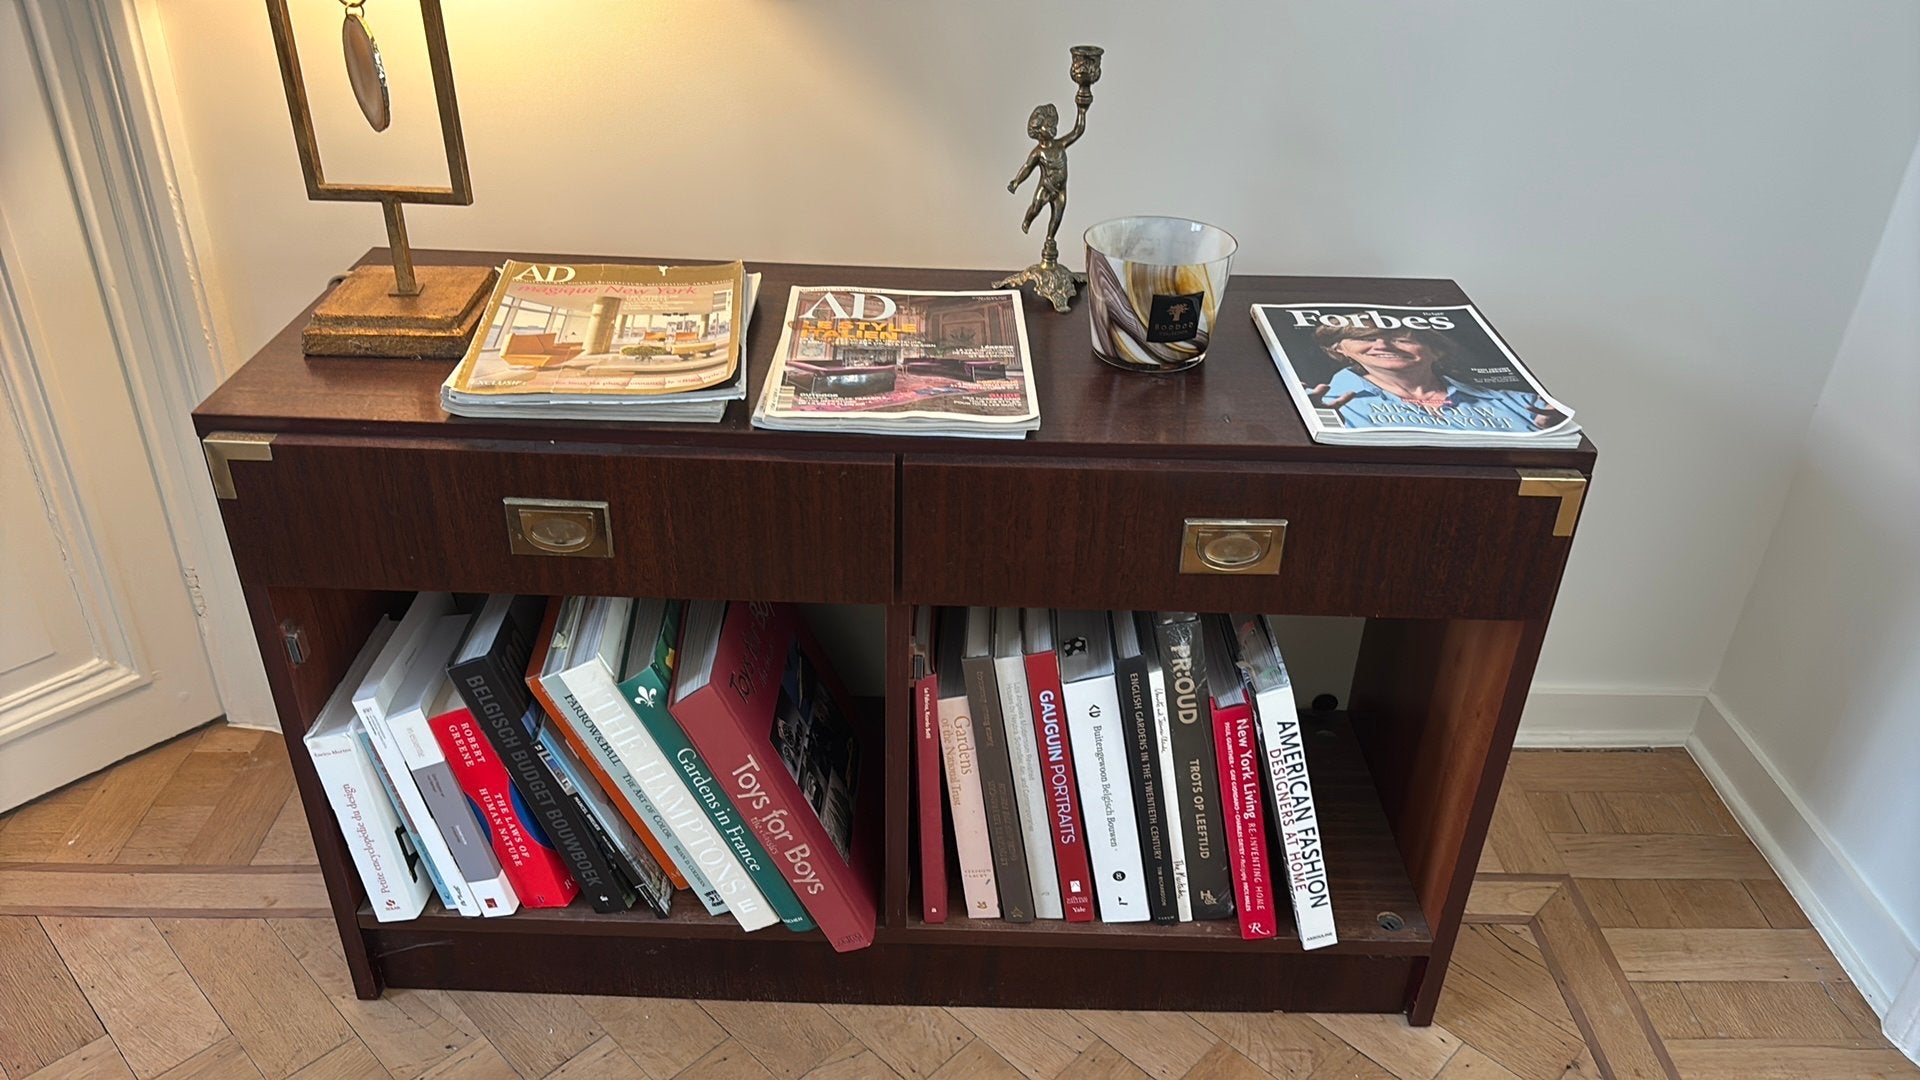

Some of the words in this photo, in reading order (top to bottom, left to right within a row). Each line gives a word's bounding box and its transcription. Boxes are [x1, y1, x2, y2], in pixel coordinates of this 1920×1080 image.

[513, 264, 576, 283] AD
[604, 285, 647, 295] New
[657, 285, 697, 295] York
[799, 291, 897, 321] AD
[1285, 309, 1455, 331] Forbes
[801, 329, 899, 341] ITALIEN
[803, 320, 833, 331] LE
[838, 321, 918, 334] STYLE
[1370, 403, 1497, 418] MEVROUW
[1453, 417, 1513, 430] VOLT
[1129, 673, 1142, 709] ENGLISH
[941, 718, 951, 730] of
[942, 730, 954, 744] the
[1133, 712, 1147, 751] GARDENS
[1236, 719, 1248, 748] New
[448, 725, 475, 768] GREENE
[461, 723, 486, 762] ROBERT
[954, 716, 974, 776] Gardens
[1093, 726, 1108, 782] Buitengewoon
[1139, 752, 1149, 761] IN
[466, 676, 522, 748] BELGISCH
[511, 749, 556, 806] BUDGET
[546, 809, 602, 887] BOUWBOEK
[945, 745, 960, 784] National
[1039, 690, 1063, 762] GAUGUIN
[1051, 765, 1076, 845] PORTRAITS
[1140, 763, 1151, 780] THE
[1190, 759, 1202, 794] TROTS
[1240, 750, 1255, 780] York
[342, 783, 358, 809] design
[591, 693, 650, 754] THE
[637, 760, 748, 898] HAMPTONS
[951, 784, 964, 808] Trust
[1103, 785, 1116, 815] Belgisch
[1143, 781, 1156, 824] TWENTIETH
[1194, 795, 1205, 811] OP
[1244, 784, 1258, 818] Living
[1269, 749, 1294, 825] DESIGNERS
[350, 809, 362, 822] du
[479, 788, 503, 826] HUMAN
[499, 827, 523, 867] NATURE
[494, 793, 509, 814] THE
[505, 816, 523, 843] LAWS
[519, 845, 530, 857] OF
[633, 787, 649, 805] ART
[651, 812, 674, 839] COLOR
[678, 749, 722, 810] Gardens
[714, 809, 730, 828] in
[725, 824, 764, 872] France
[732, 754, 771, 809] Toys
[760, 810, 793, 839] for
[785, 844, 825, 895] Boys
[1276, 723, 1313, 822] AMERICAN
[1297, 827, 1328, 908] FASHION
[1107, 817, 1118, 847] Bouwen
[1149, 826, 1161, 861] CENTURY
[1196, 813, 1210, 860] LEEFTIJD
[1284, 830, 1298, 847] AT
[1248, 823, 1263, 883] RE-INVENTING
[1289, 853, 1306, 891] HOME
[1255, 887, 1266, 910] HOME
